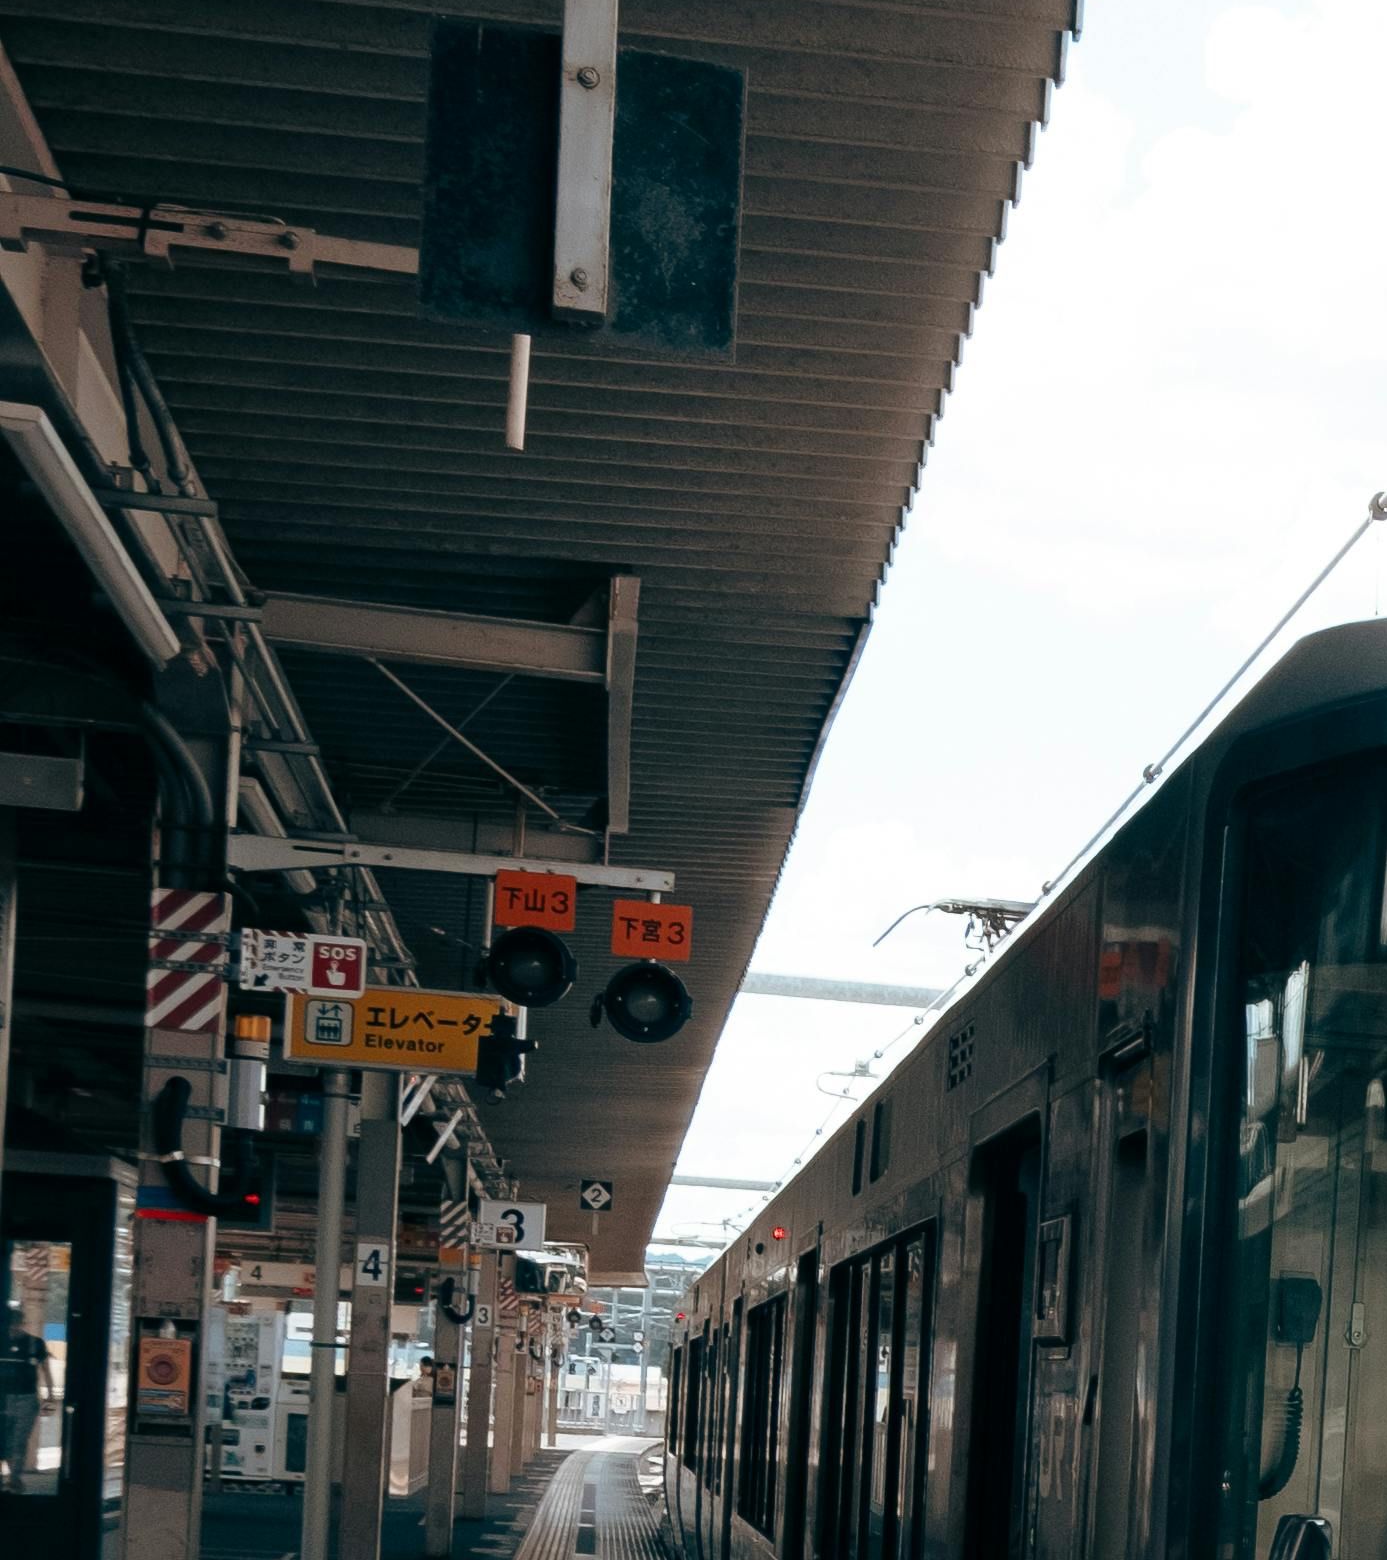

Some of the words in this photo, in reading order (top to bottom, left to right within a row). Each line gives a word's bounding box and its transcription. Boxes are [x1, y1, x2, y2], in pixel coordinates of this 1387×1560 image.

[501, 886, 570, 915] 下山3
[618, 916, 685, 945] 下宮3
[318, 945, 358, 961] SOS
[364, 1033, 446, 1054] Elevator
[591, 1187, 602, 1203] 2
[500, 1208, 525, 1244] 3
[250, 1264, 263, 1281] 4
[361, 1248, 382, 1282] 4
[477, 1307, 489, 1324] 3
